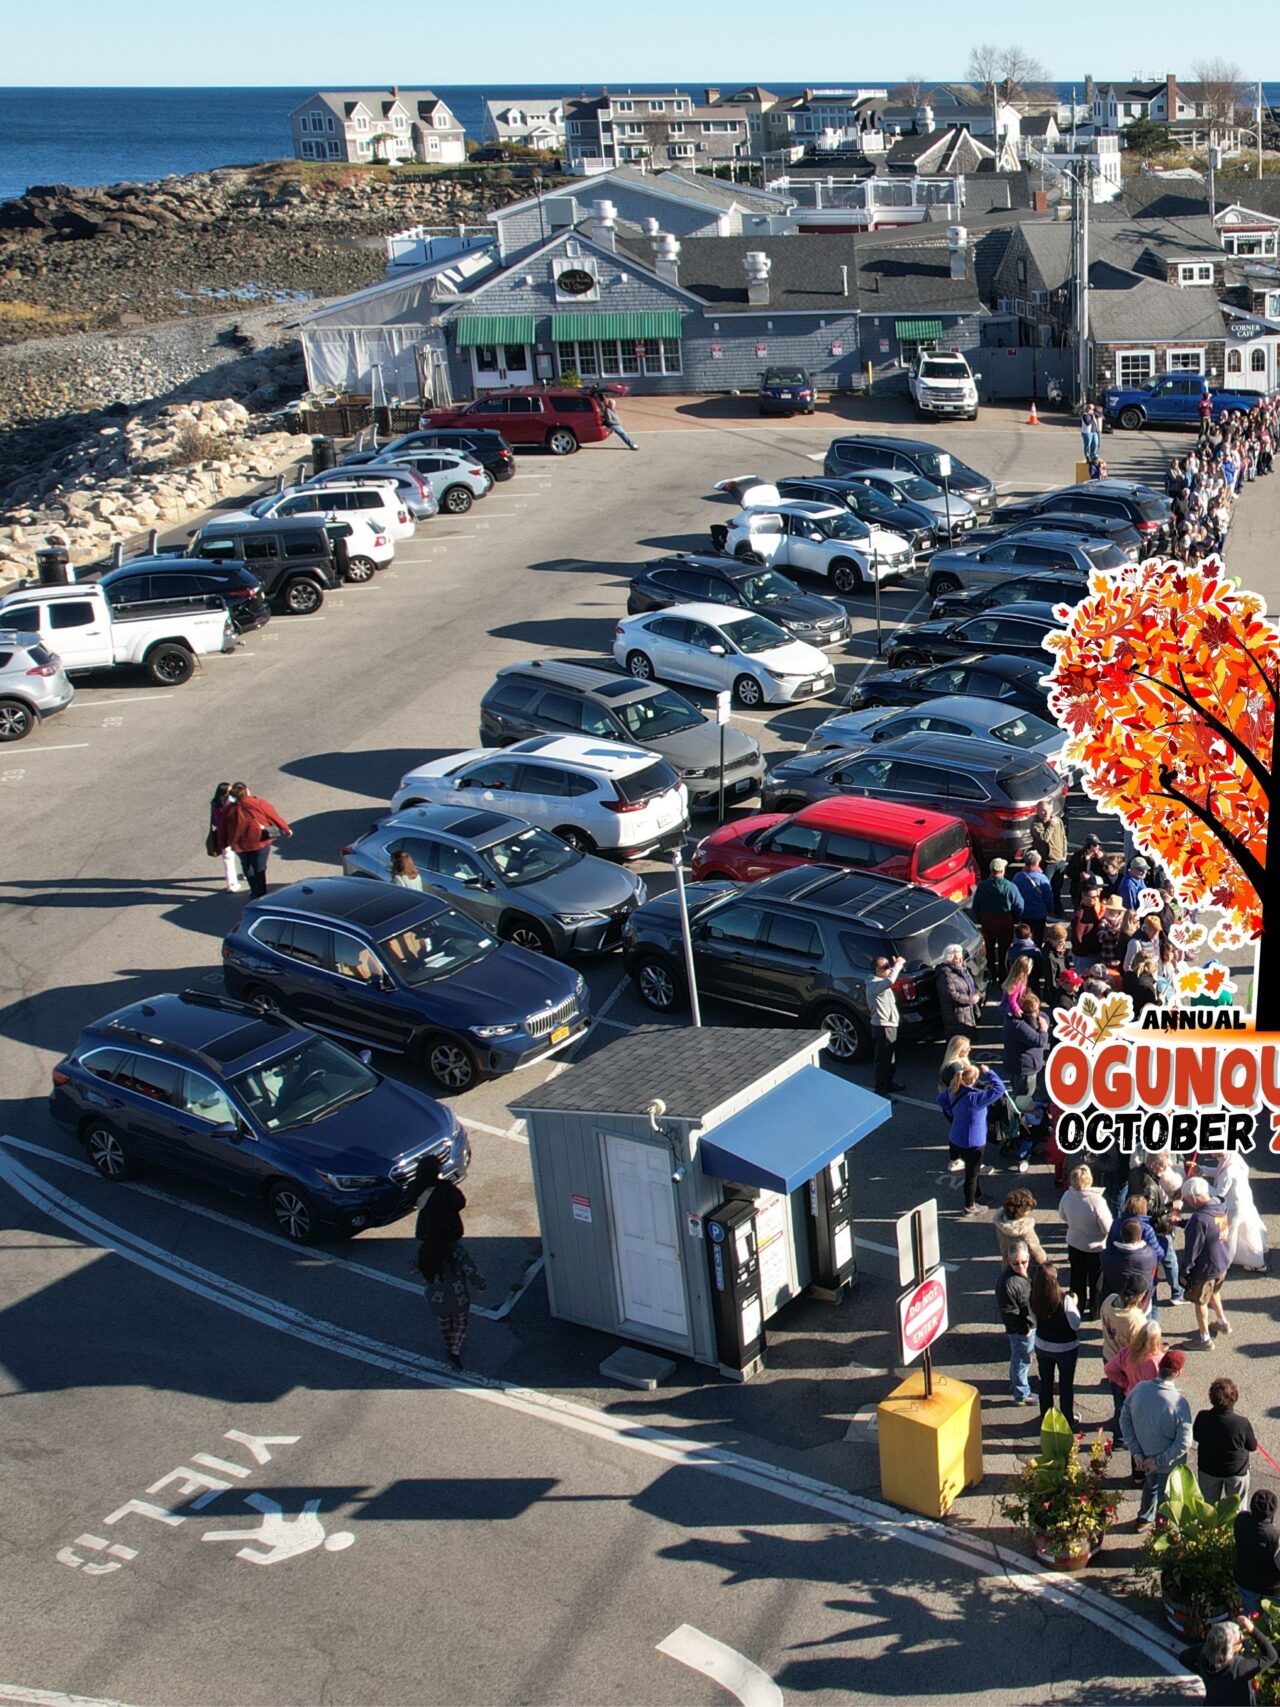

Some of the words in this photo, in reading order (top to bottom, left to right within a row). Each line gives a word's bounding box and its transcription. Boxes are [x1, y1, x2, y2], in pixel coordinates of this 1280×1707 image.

[909, 1302, 922, 1318] DO
[922, 1286, 939, 1304] NOT
[912, 1318, 939, 1344] ENTER
[55, 1429, 302, 1576] YIELD
